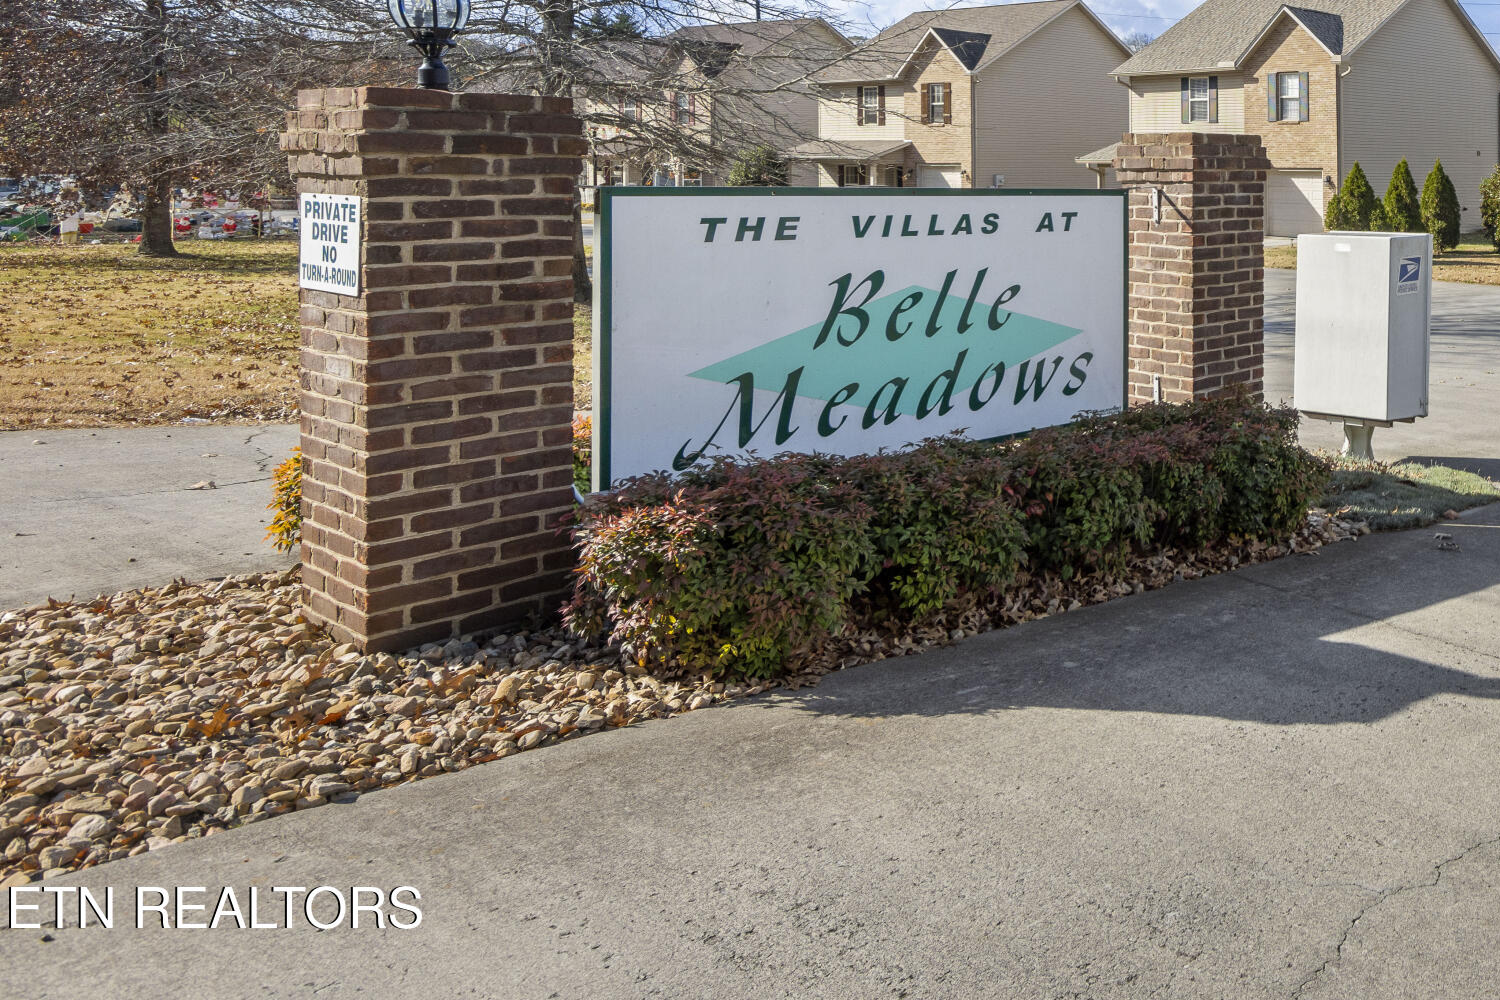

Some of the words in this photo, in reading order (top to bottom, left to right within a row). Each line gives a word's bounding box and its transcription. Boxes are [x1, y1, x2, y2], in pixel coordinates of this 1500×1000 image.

[304, 200, 357, 223] PRIVATE
[311, 222, 348, 244] DRIVE
[699, 216, 801, 243] THE
[851, 212, 1000, 239] VILLAS
[1035, 211, 1079, 233] AT
[322, 245, 338, 264] NO
[301, 263, 357, 288] TURN-A-ROUND
[812, 266, 1021, 351] Belle
[672, 347, 1094, 472] Meadows
